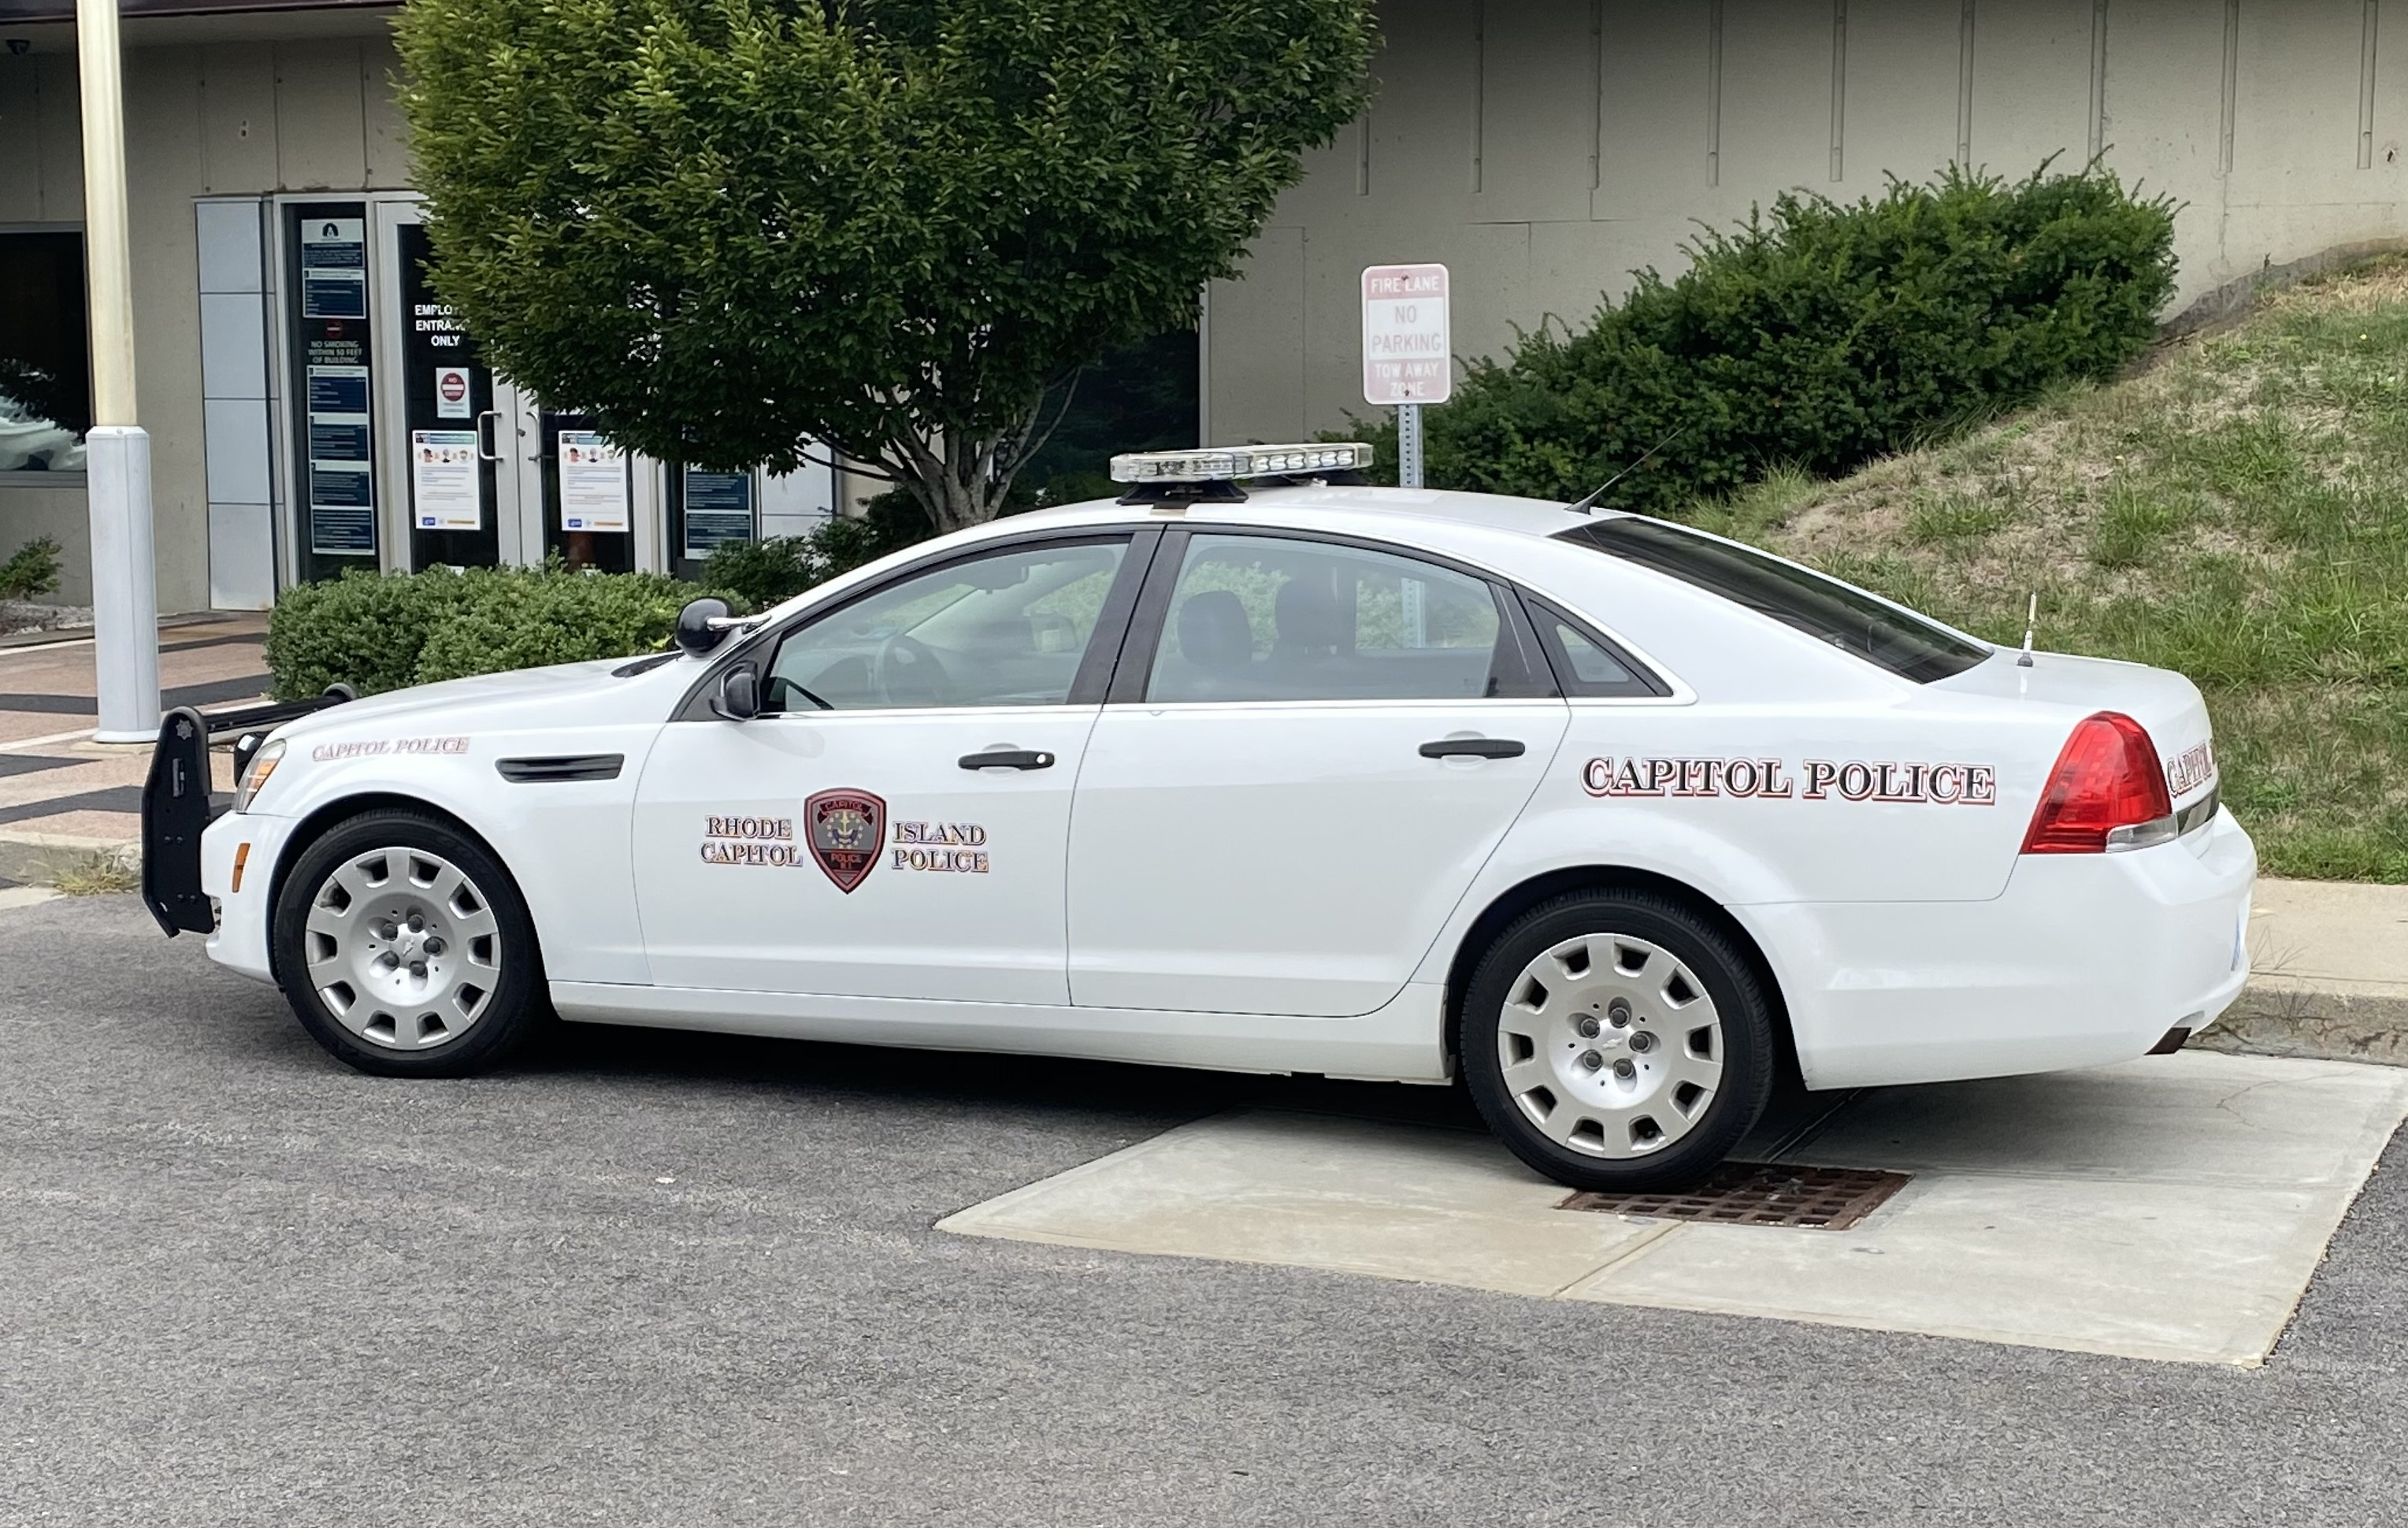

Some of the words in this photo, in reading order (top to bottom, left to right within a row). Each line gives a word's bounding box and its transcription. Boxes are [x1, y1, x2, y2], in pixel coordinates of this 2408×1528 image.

[1371, 278, 1401, 294] FIRE
[1405, 276, 1440, 292] LANE
[1395, 305, 1416, 324] NO
[430, 335, 460, 347] ONLY
[1373, 333, 1441, 354] PARKING
[1375, 364, 1401, 379] TOW
[1405, 362, 1438, 378] AWAY
[1390, 381, 1425, 397] ZONE
[313, 740, 391, 762] CAPITOL
[392, 736, 471, 755] POLICE
[1580, 757, 1793, 798] CAPITOL
[1803, 758, 1996, 806] POLICE
[825, 800, 863, 811] CAPITOL
[705, 815, 792, 840] RHODE
[892, 821, 987, 847] ISLAND
[700, 841, 803, 867] CAPITOL
[831, 853, 863, 863] POLICE
[892, 847, 989, 873] POLICE
